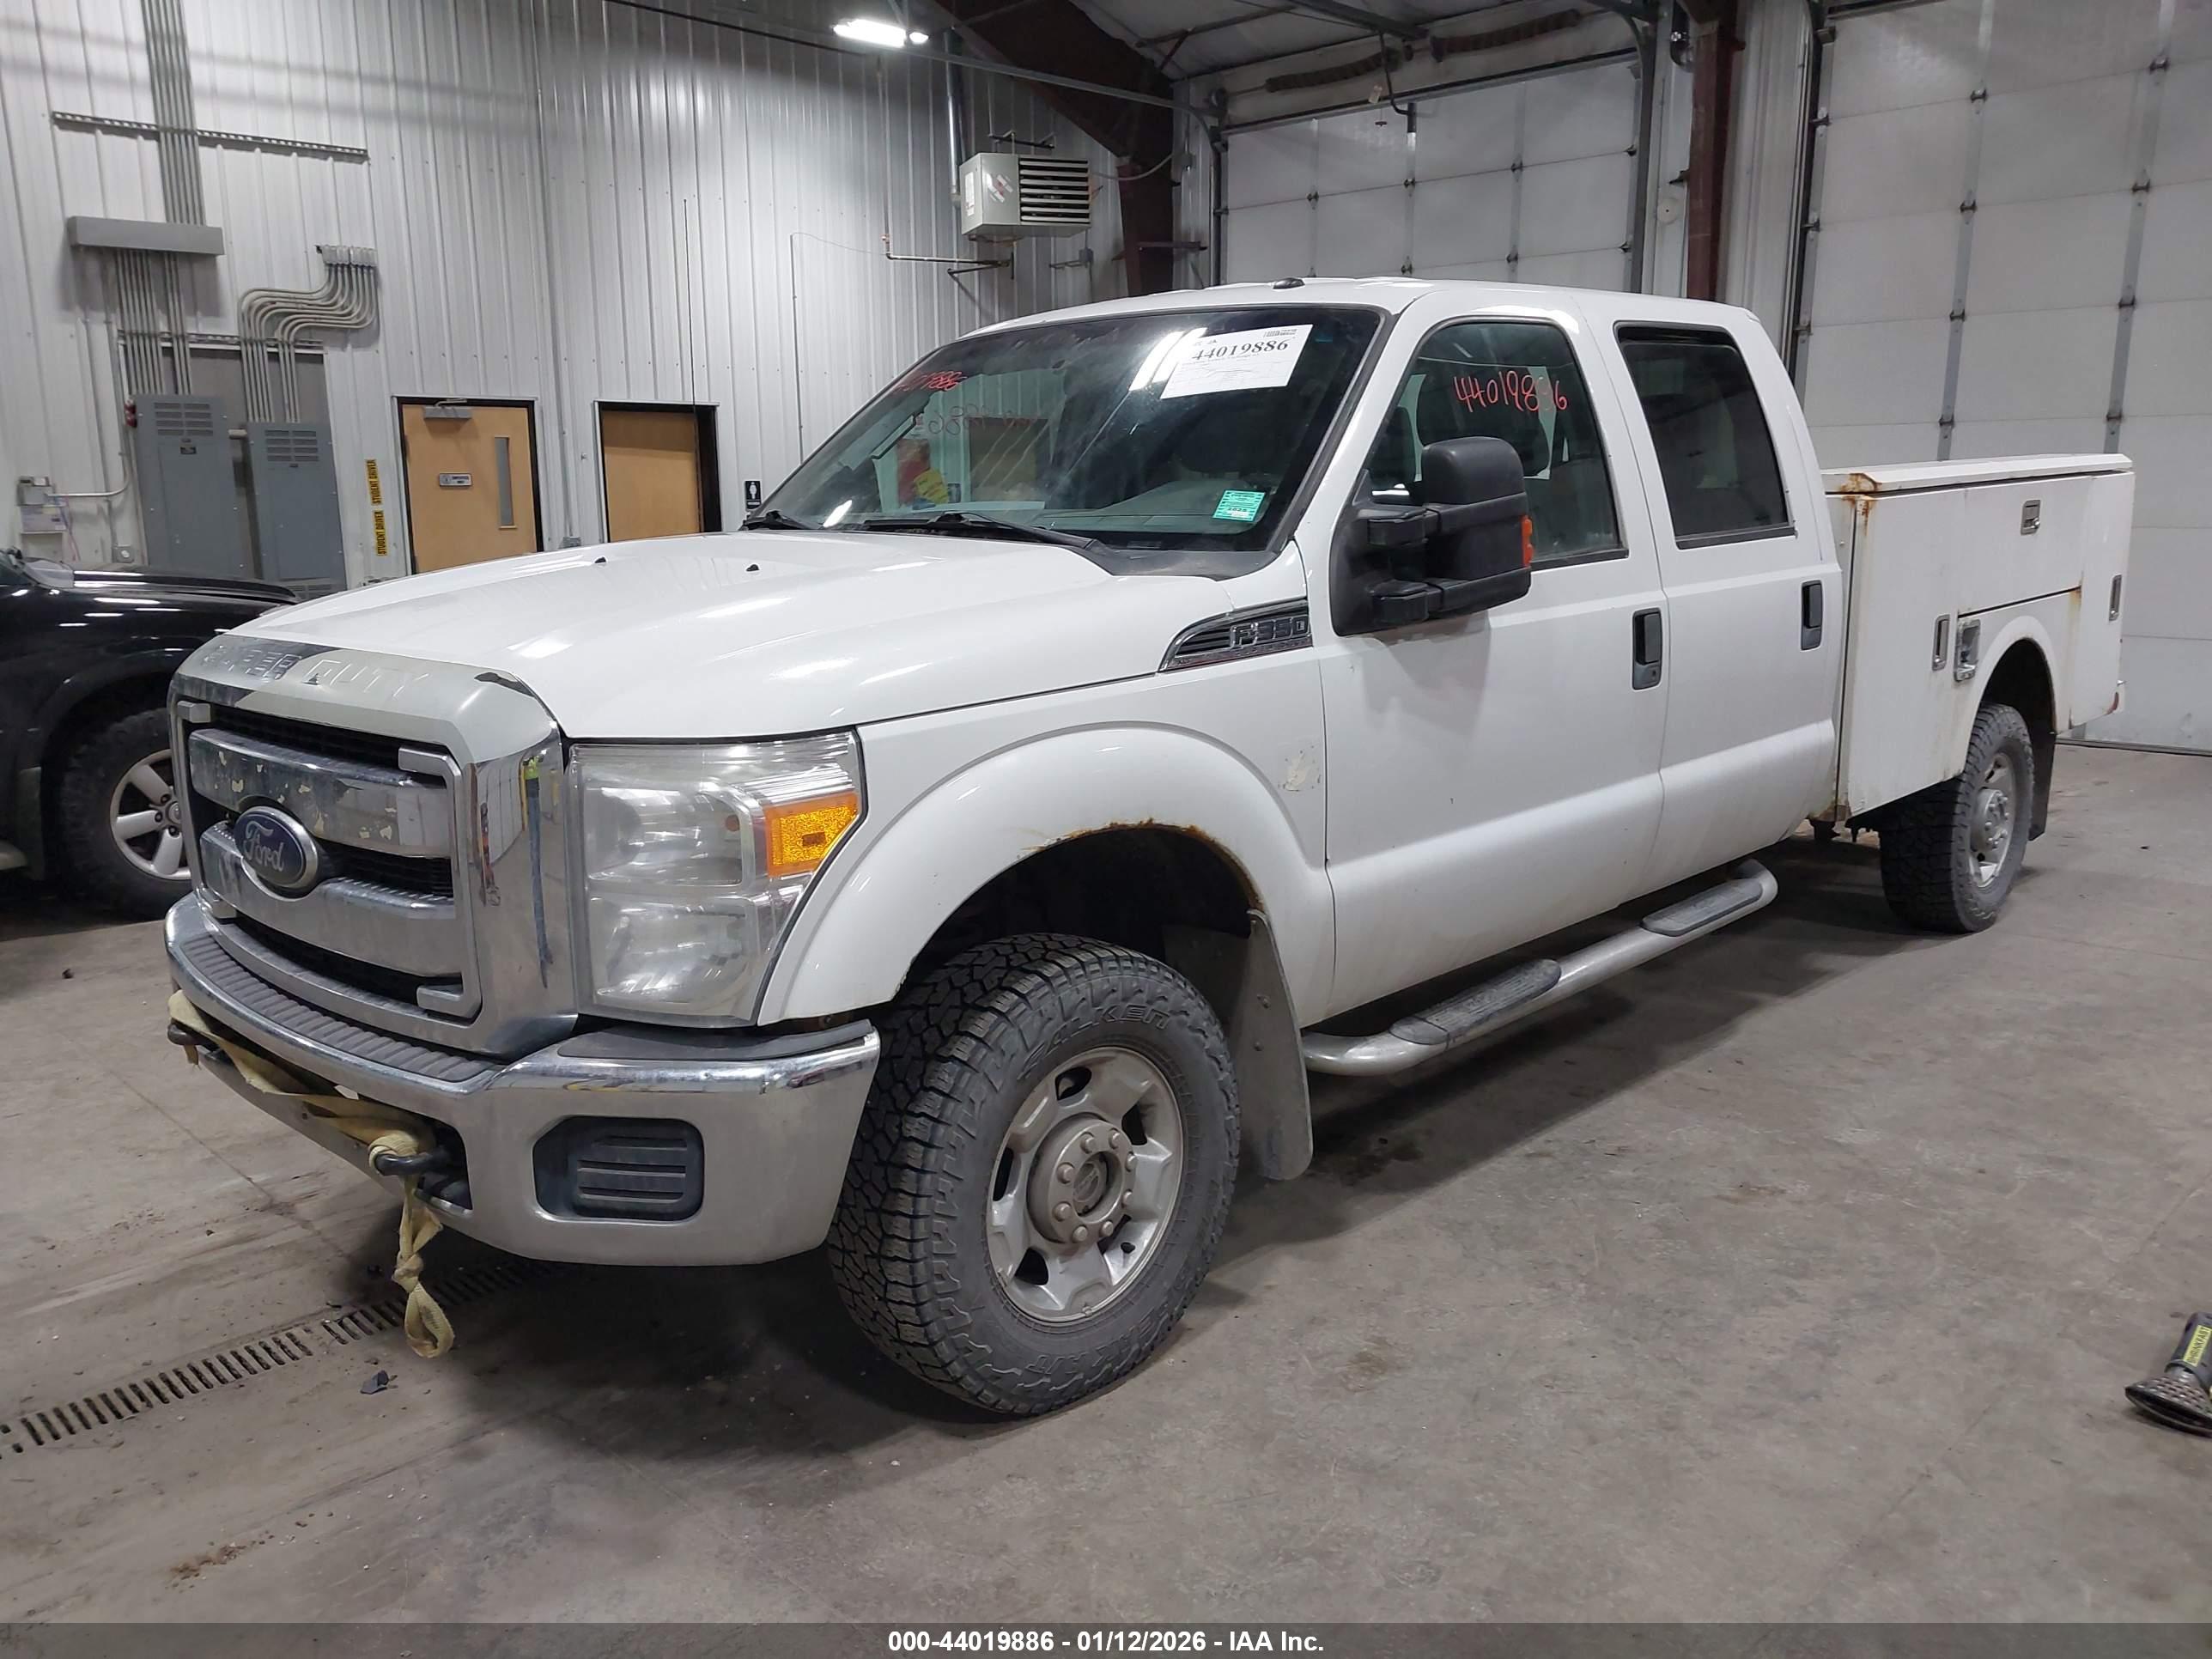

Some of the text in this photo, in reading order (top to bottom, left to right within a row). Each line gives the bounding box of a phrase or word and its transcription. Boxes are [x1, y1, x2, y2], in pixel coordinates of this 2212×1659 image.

[1191, 339, 1291, 361] 44019886
[366, 459, 381, 505] STUDENT DRIVER
[374, 510, 387, 555] STUDENT DRIVER
[301, 659, 429, 697] DUTY
[243, 820, 285, 872] Ford
